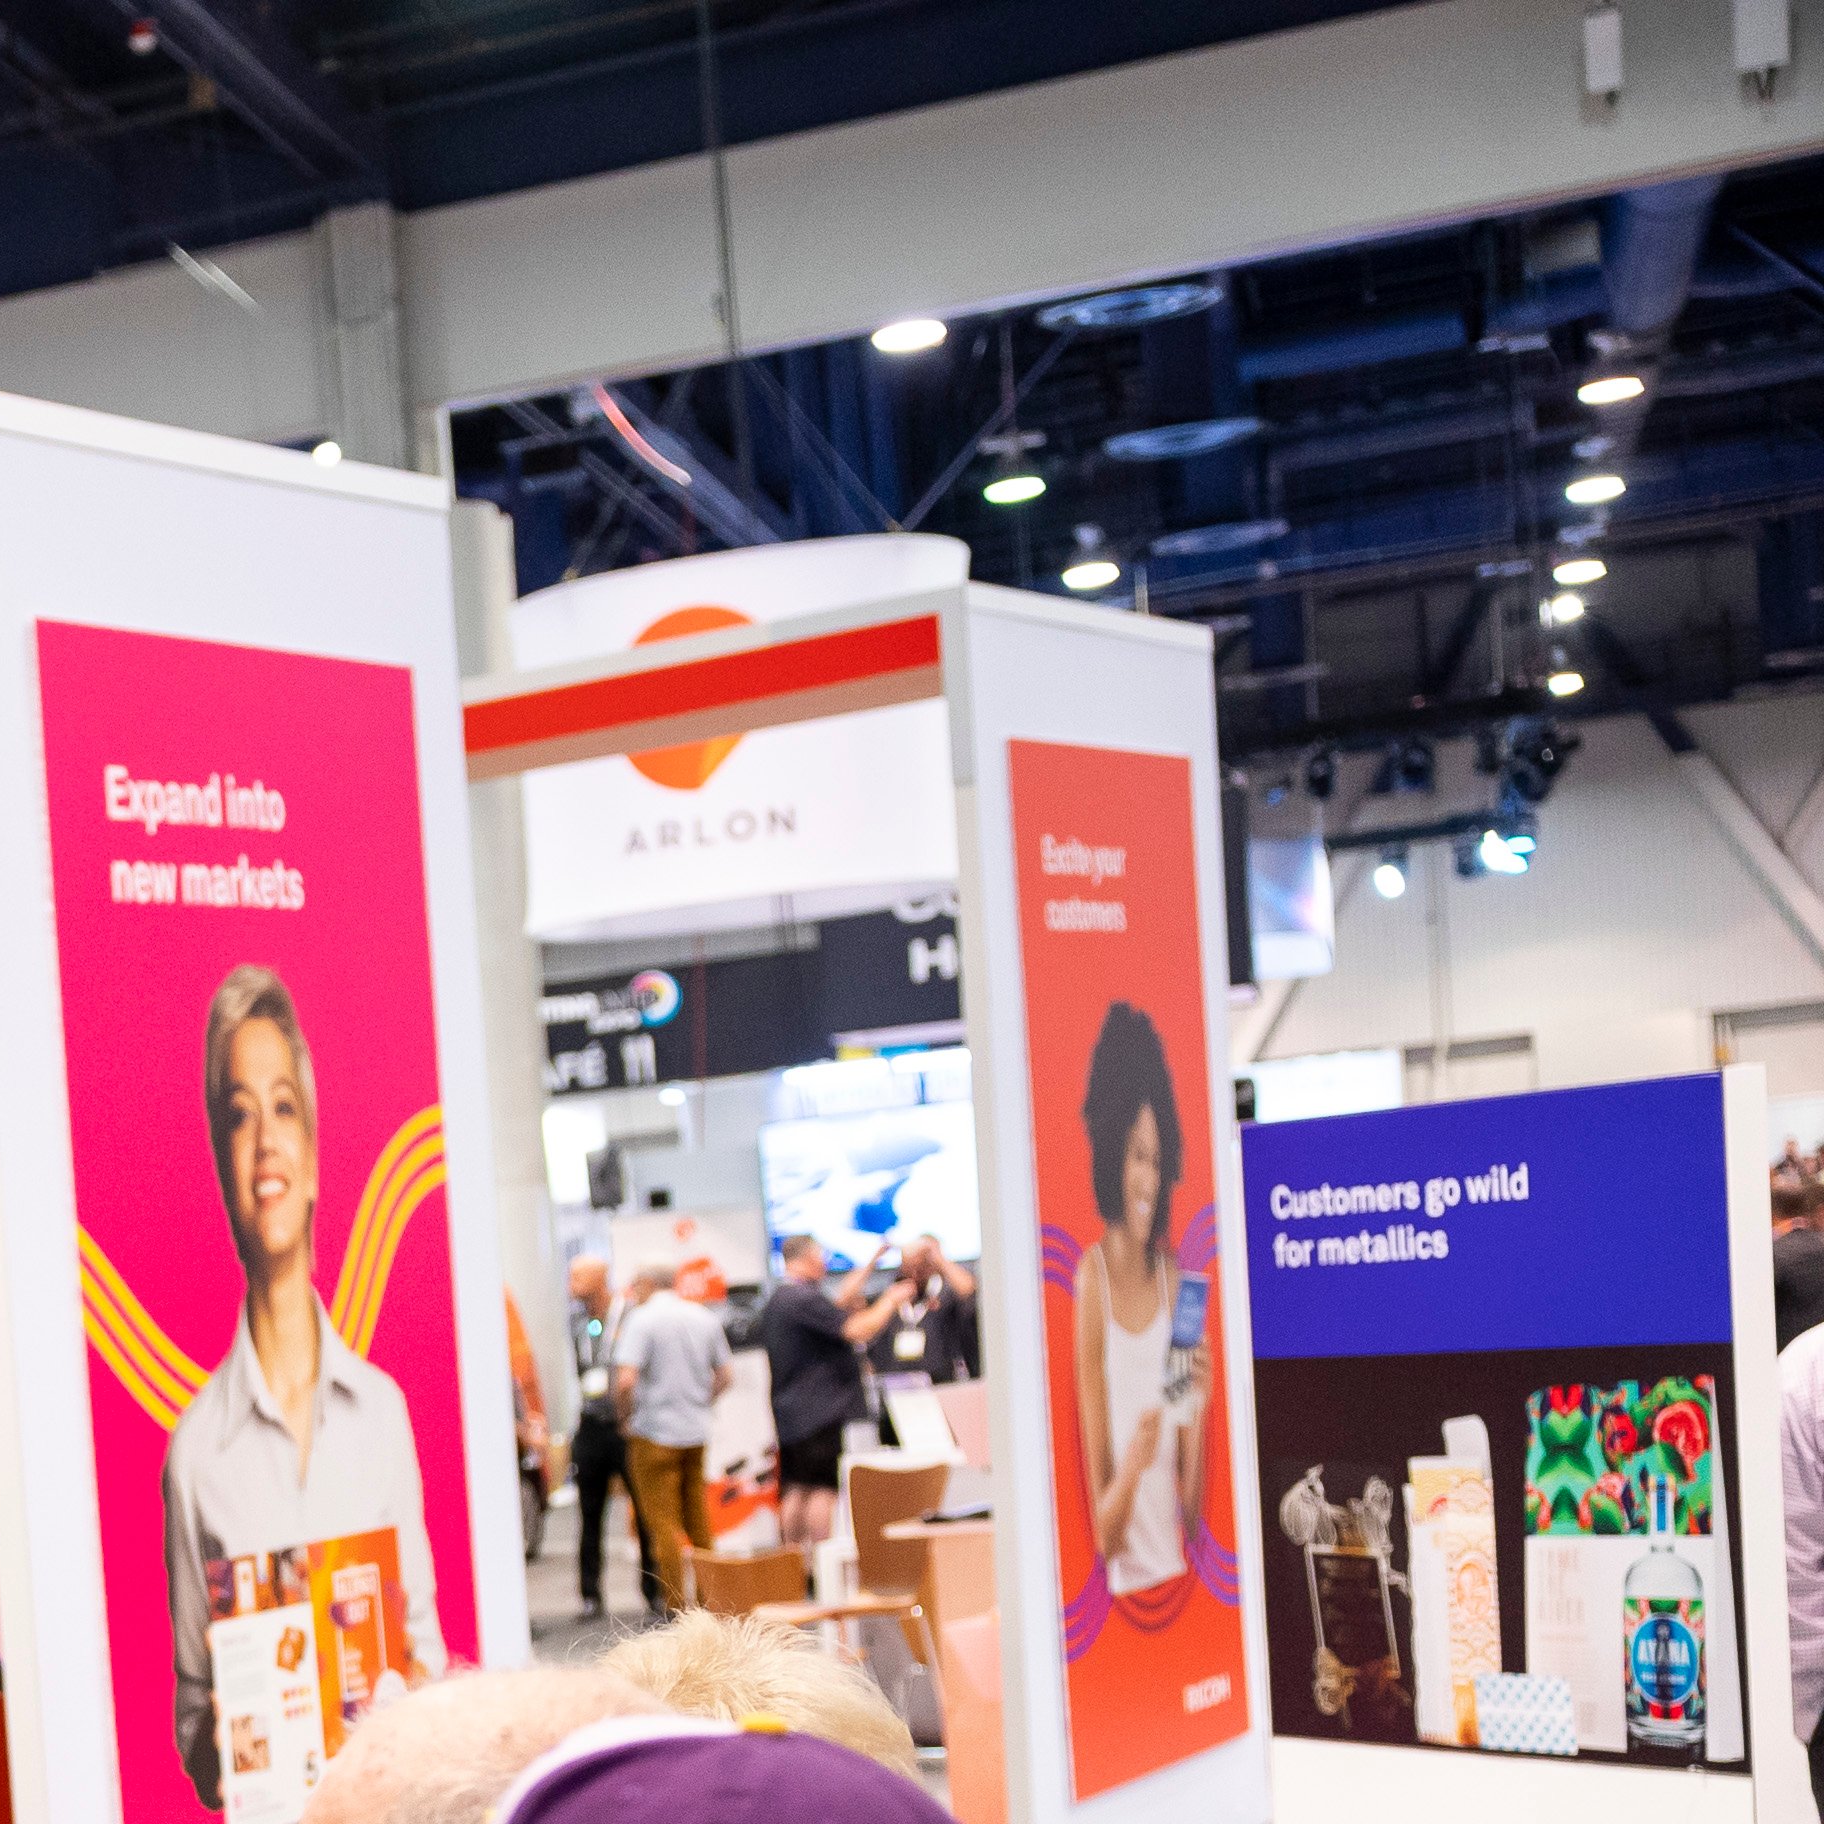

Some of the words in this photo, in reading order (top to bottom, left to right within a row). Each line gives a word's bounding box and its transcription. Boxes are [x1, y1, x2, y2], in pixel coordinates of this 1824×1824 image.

[104, 763, 223, 836] Expand
[224, 771, 287, 833] into
[622, 806, 800, 856] ARLON
[110, 858, 177, 905] new
[179, 852, 306, 911] markets
[1269, 1178, 1421, 1222] Customers
[1423, 1176, 1461, 1218] go
[1463, 1162, 1530, 1205] wild
[1272, 1231, 1314, 1269] for
[1317, 1224, 1450, 1267] metallics
